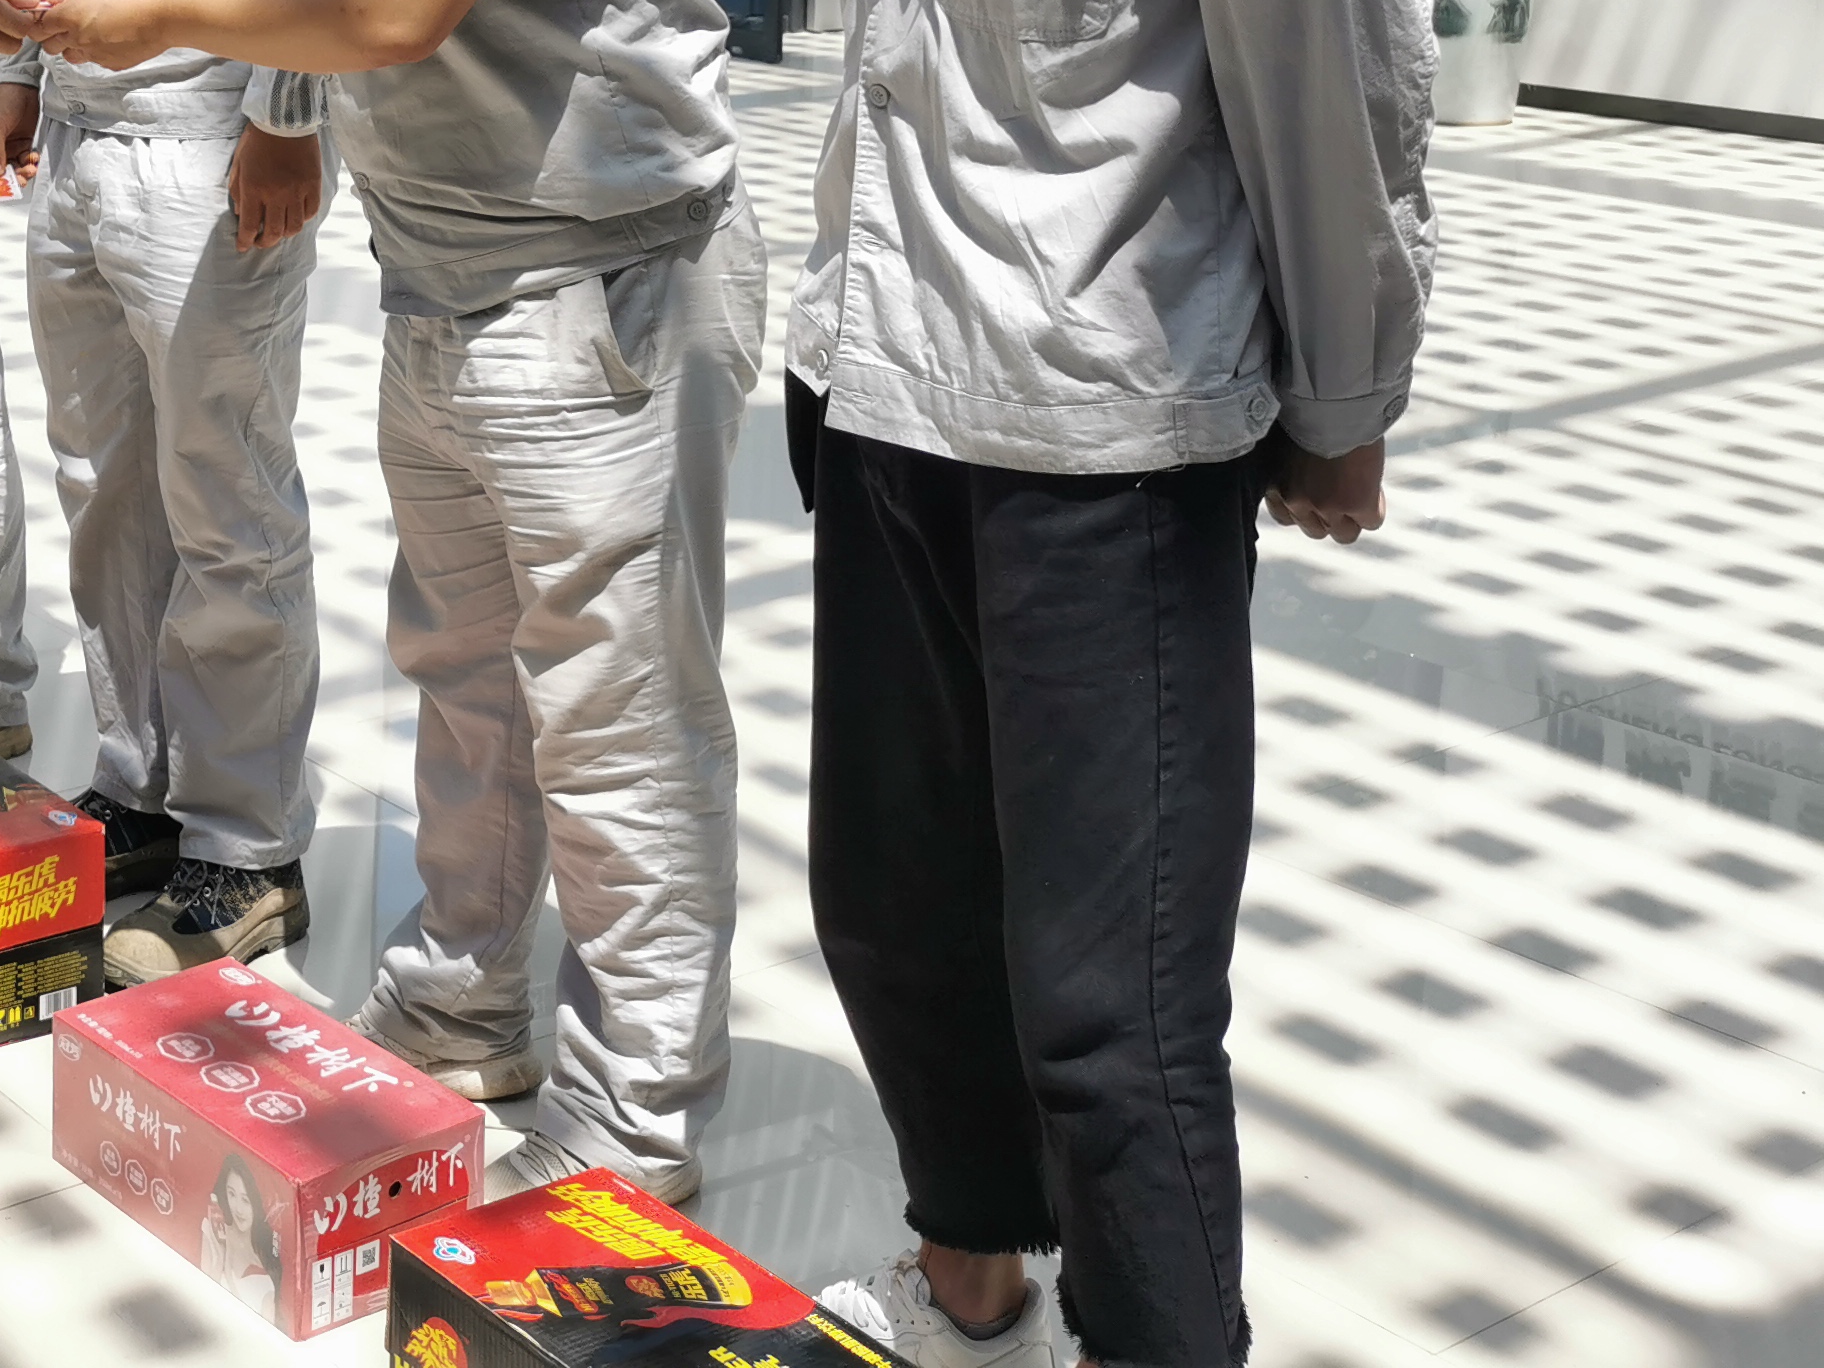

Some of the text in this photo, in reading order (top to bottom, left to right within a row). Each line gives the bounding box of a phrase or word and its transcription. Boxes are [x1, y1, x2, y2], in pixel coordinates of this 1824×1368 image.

[225, 999, 398, 1094] 山楂树下
[89, 1074, 183, 1160] 山楂树下
[314, 1147, 465, 1235] 山楂树下
